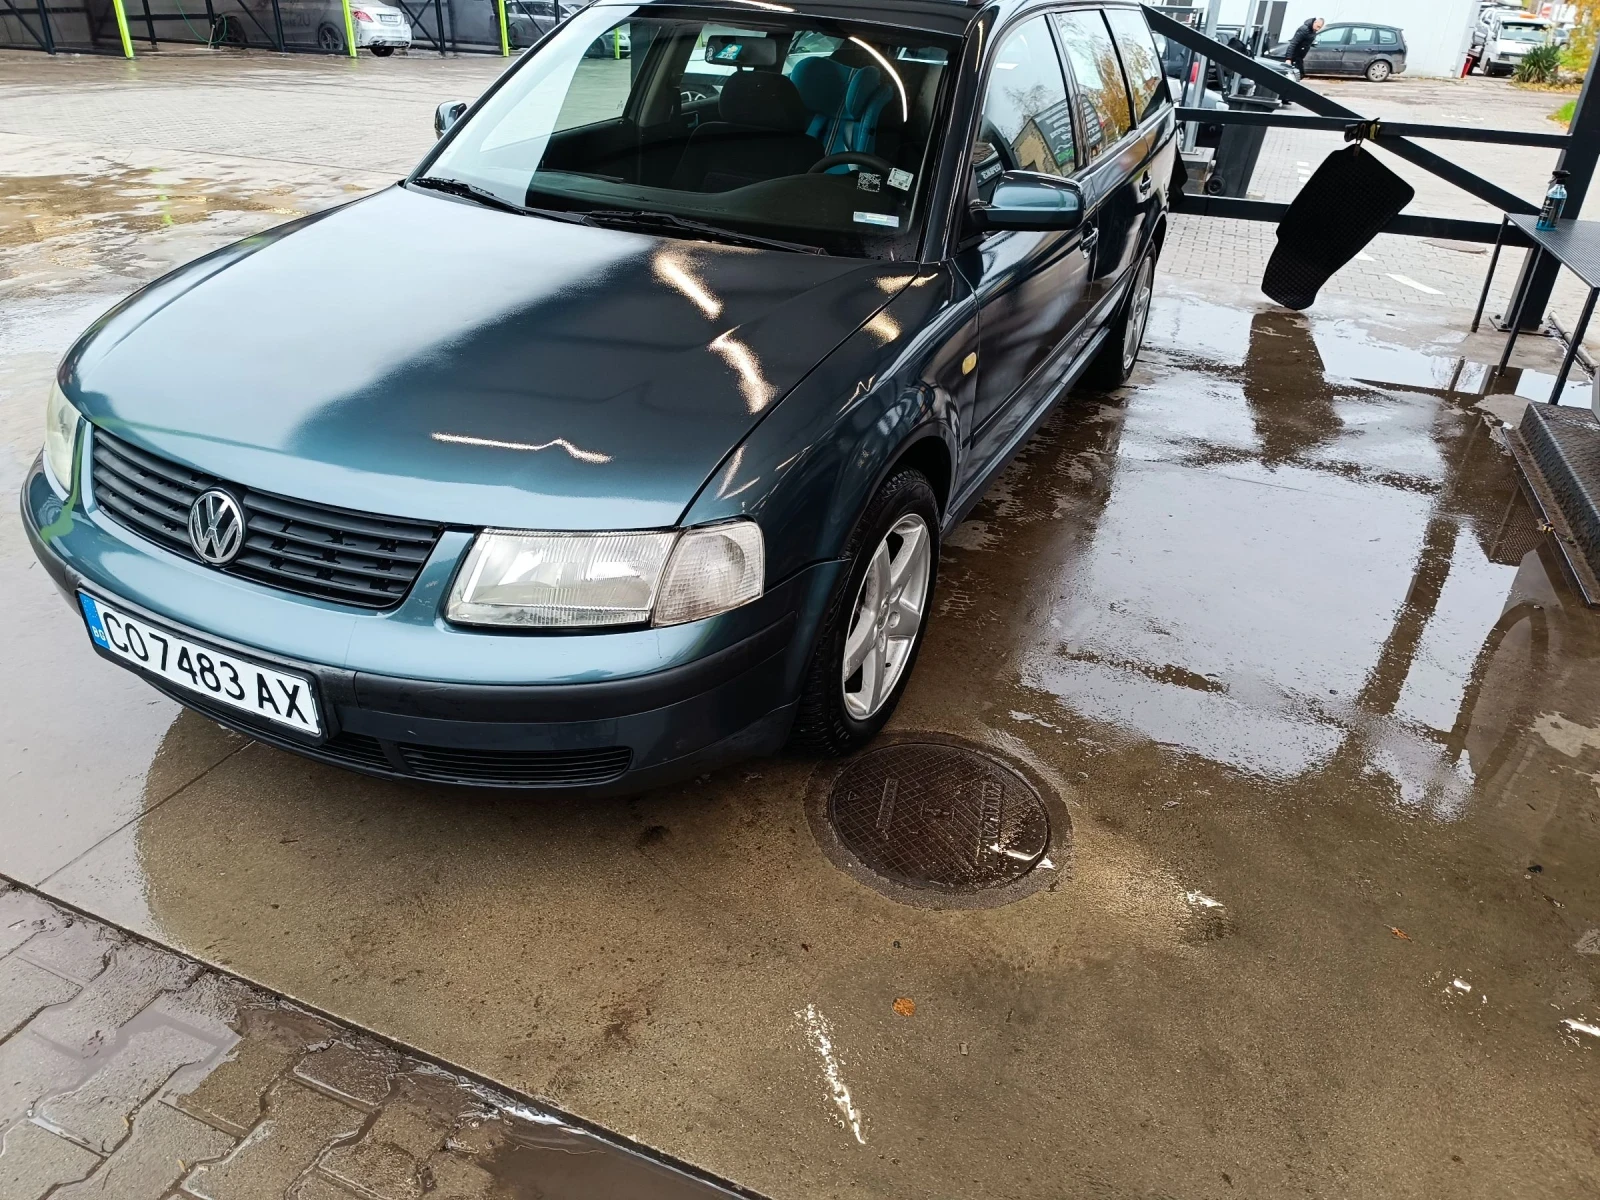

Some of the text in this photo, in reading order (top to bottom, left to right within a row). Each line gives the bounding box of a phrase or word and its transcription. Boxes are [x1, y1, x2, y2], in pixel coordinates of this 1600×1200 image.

[190, 490, 245, 563] VW
[92, 625, 106, 641] BG
[256, 673, 309, 724] AX
